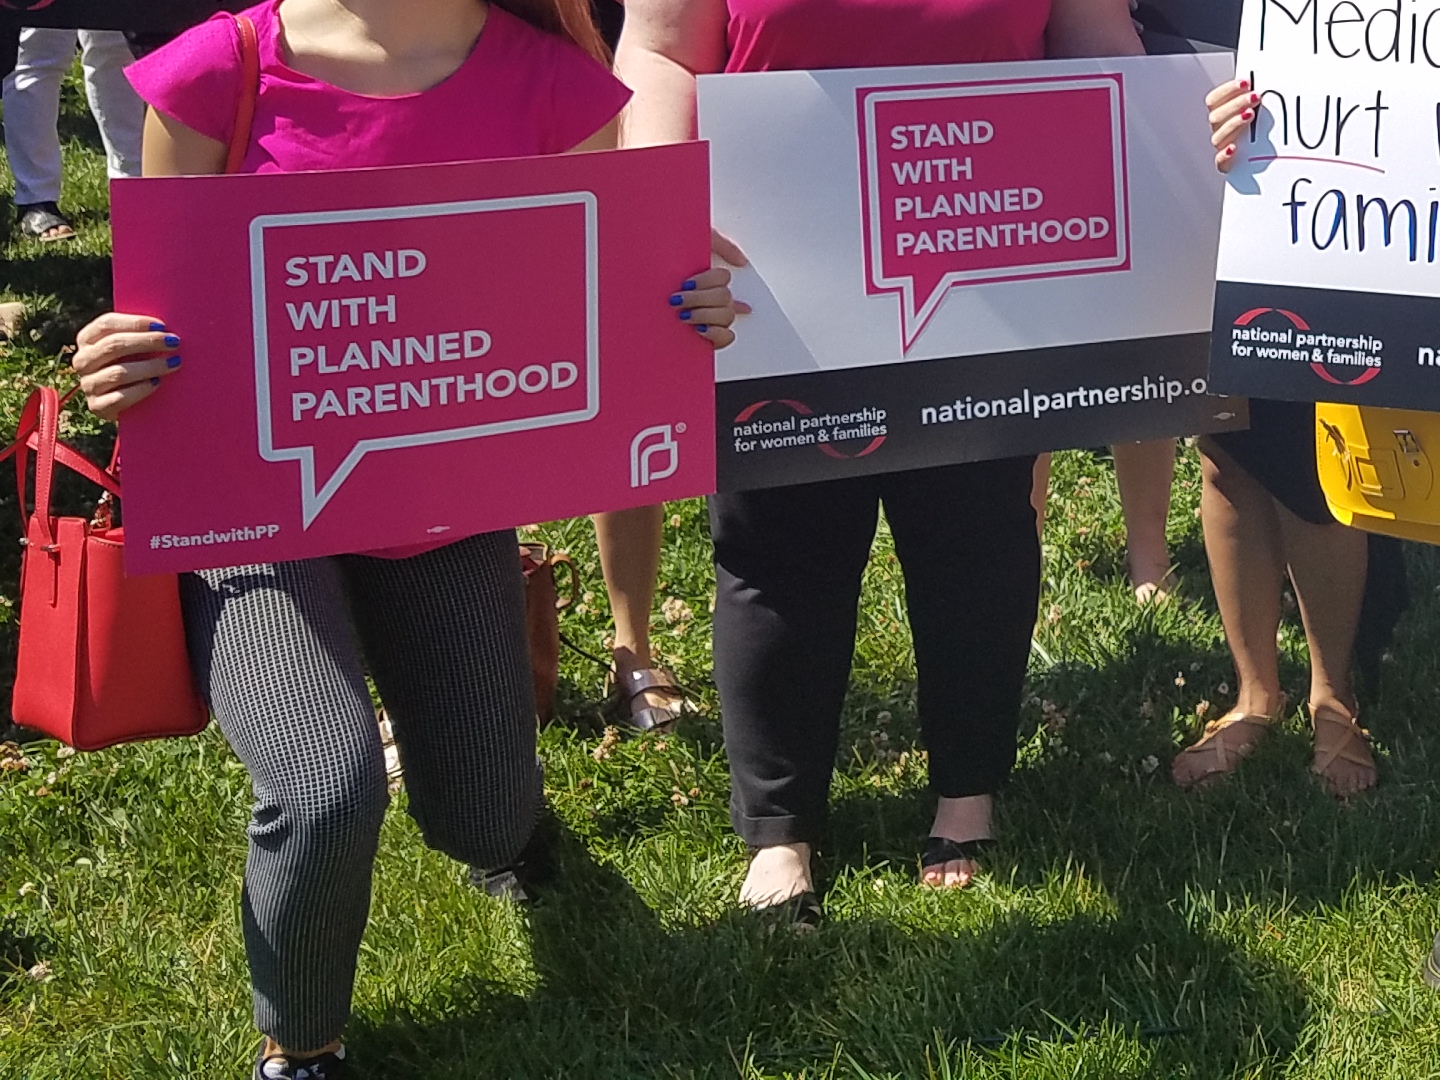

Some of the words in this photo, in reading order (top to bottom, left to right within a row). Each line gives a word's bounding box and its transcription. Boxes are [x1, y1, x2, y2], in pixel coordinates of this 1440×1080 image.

[889, 120, 994, 151] STAND
[891, 156, 973, 185] WITH
[894, 187, 1044, 221] PLANNED
[896, 216, 1110, 257] PARENTHOOD
[285, 248, 426, 287] STAND
[286, 295, 397, 331] WITH
[289, 329, 492, 376] PLANNED
[1231, 326, 1292, 344] national
[1295, 331, 1383, 353] partnership
[1231, 342, 1253, 358] for
[1255, 345, 1308, 362] women
[1311, 347, 1325, 363] &
[1327, 349, 1382, 368] families
[292, 360, 578, 421] PARENTHOOD
[921, 375, 1217, 426] nationalpartnership.o
[733, 416, 796, 437] national
[799, 406, 887, 432] partnership
[734, 437, 757, 453] for
[759, 431, 816, 450] women
[817, 428, 830, 443] &
[832, 422, 888, 441] families
[148, 523, 280, 551] #StandwithPP
